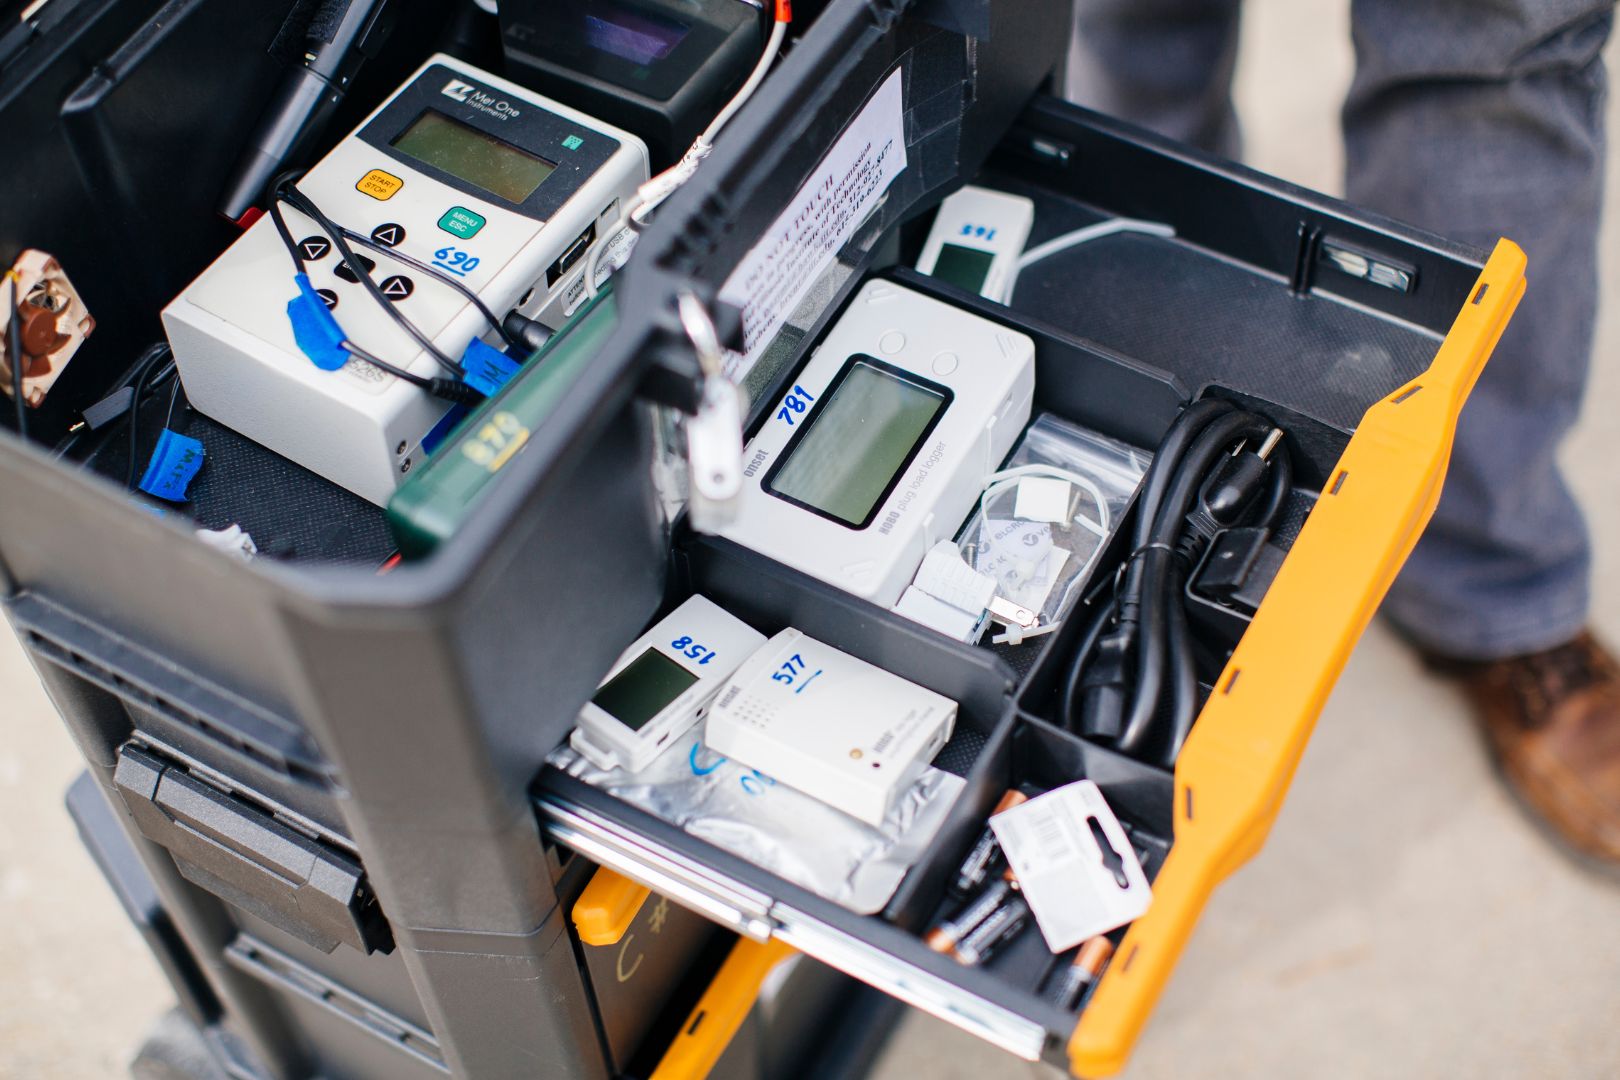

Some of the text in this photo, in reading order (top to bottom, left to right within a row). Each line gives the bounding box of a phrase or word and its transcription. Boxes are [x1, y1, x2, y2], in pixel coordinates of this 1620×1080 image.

[466, 99, 509, 121] Instruments
[472, 91, 521, 119] Met One
[369, 174, 396, 189] START
[833, 141, 872, 201] permission
[364, 182, 387, 195] STOP
[832, 156, 872, 215] Technology
[794, 173, 834, 230] TOUCH
[448, 220, 468, 232] ESC
[452, 211, 478, 228] MENU
[609, 233, 625, 248] USB
[433, 246, 480, 273] 690
[776, 384, 815, 426] 781
[743, 449, 769, 478] onset
[878, 441, 947, 536] HOBO plug load logger
[671, 635, 717, 666] 158
[771, 653, 806, 686] 577
